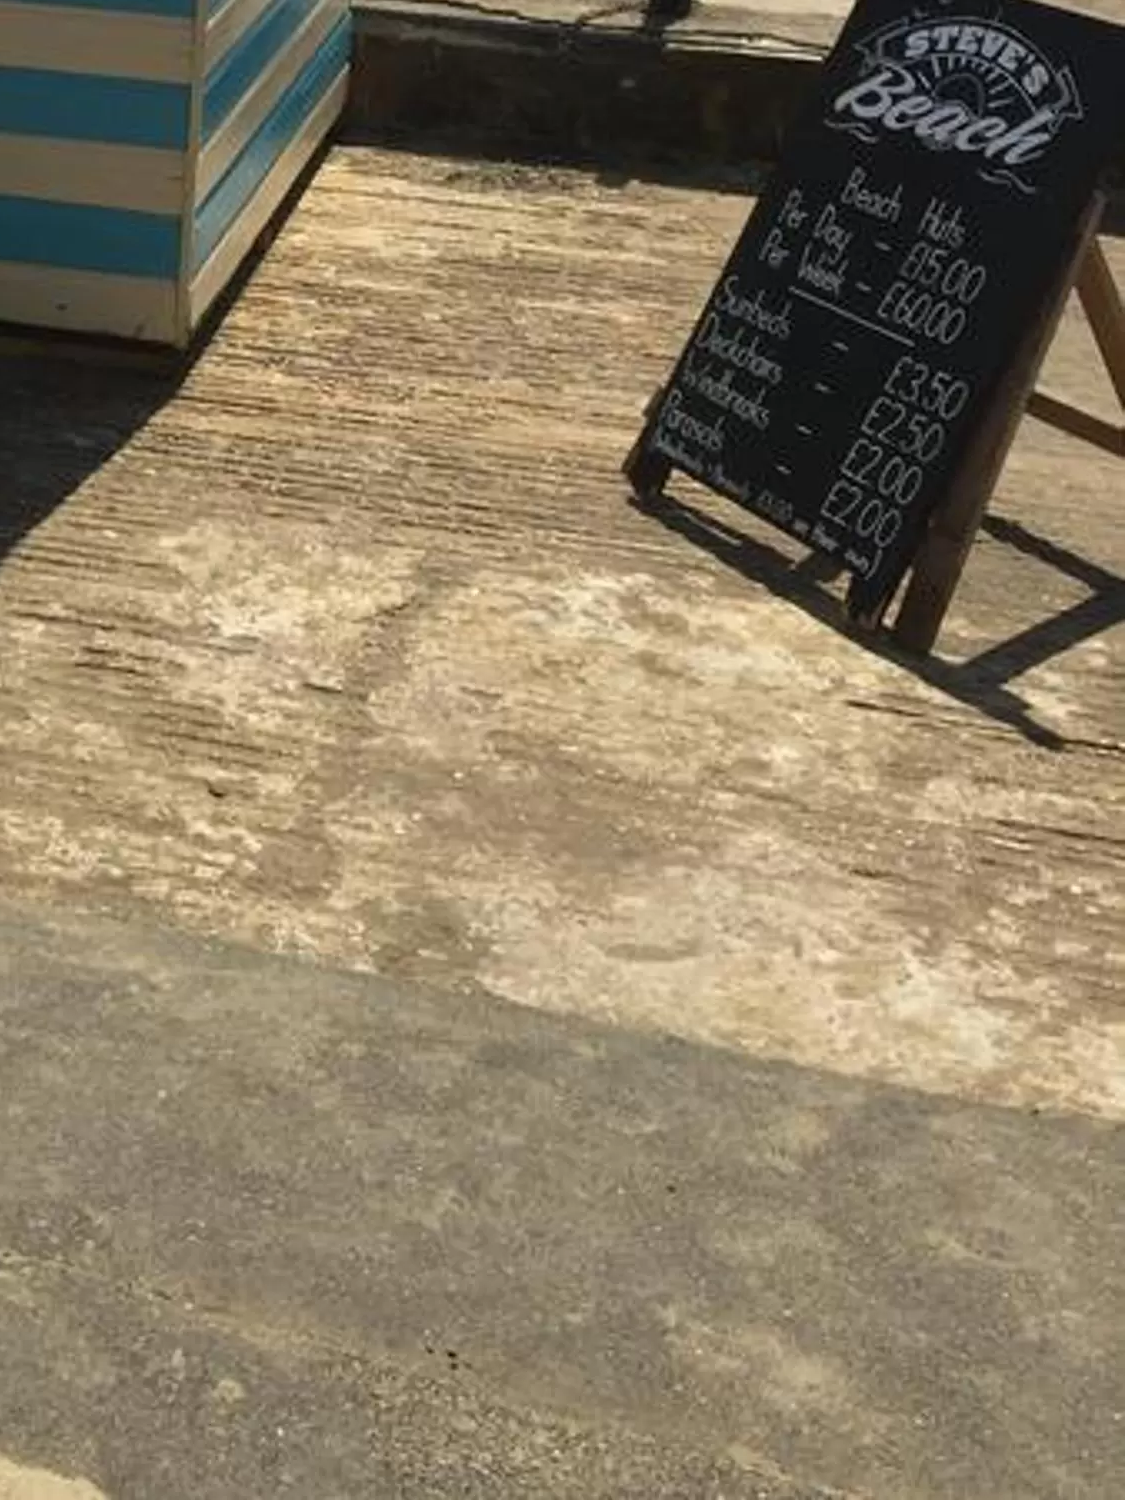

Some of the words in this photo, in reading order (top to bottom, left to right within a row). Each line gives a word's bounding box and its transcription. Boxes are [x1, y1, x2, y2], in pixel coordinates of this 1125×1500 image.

[905, 25, 1049, 96] STEVE'S
[834, 62, 1054, 165] Beach
[778, 188, 808, 228] Per
[813, 203, 854, 264] Day
[841, 166, 903, 222] Beach
[918, 197, 966, 248] Huts
[758, 228, 789, 269] Per
